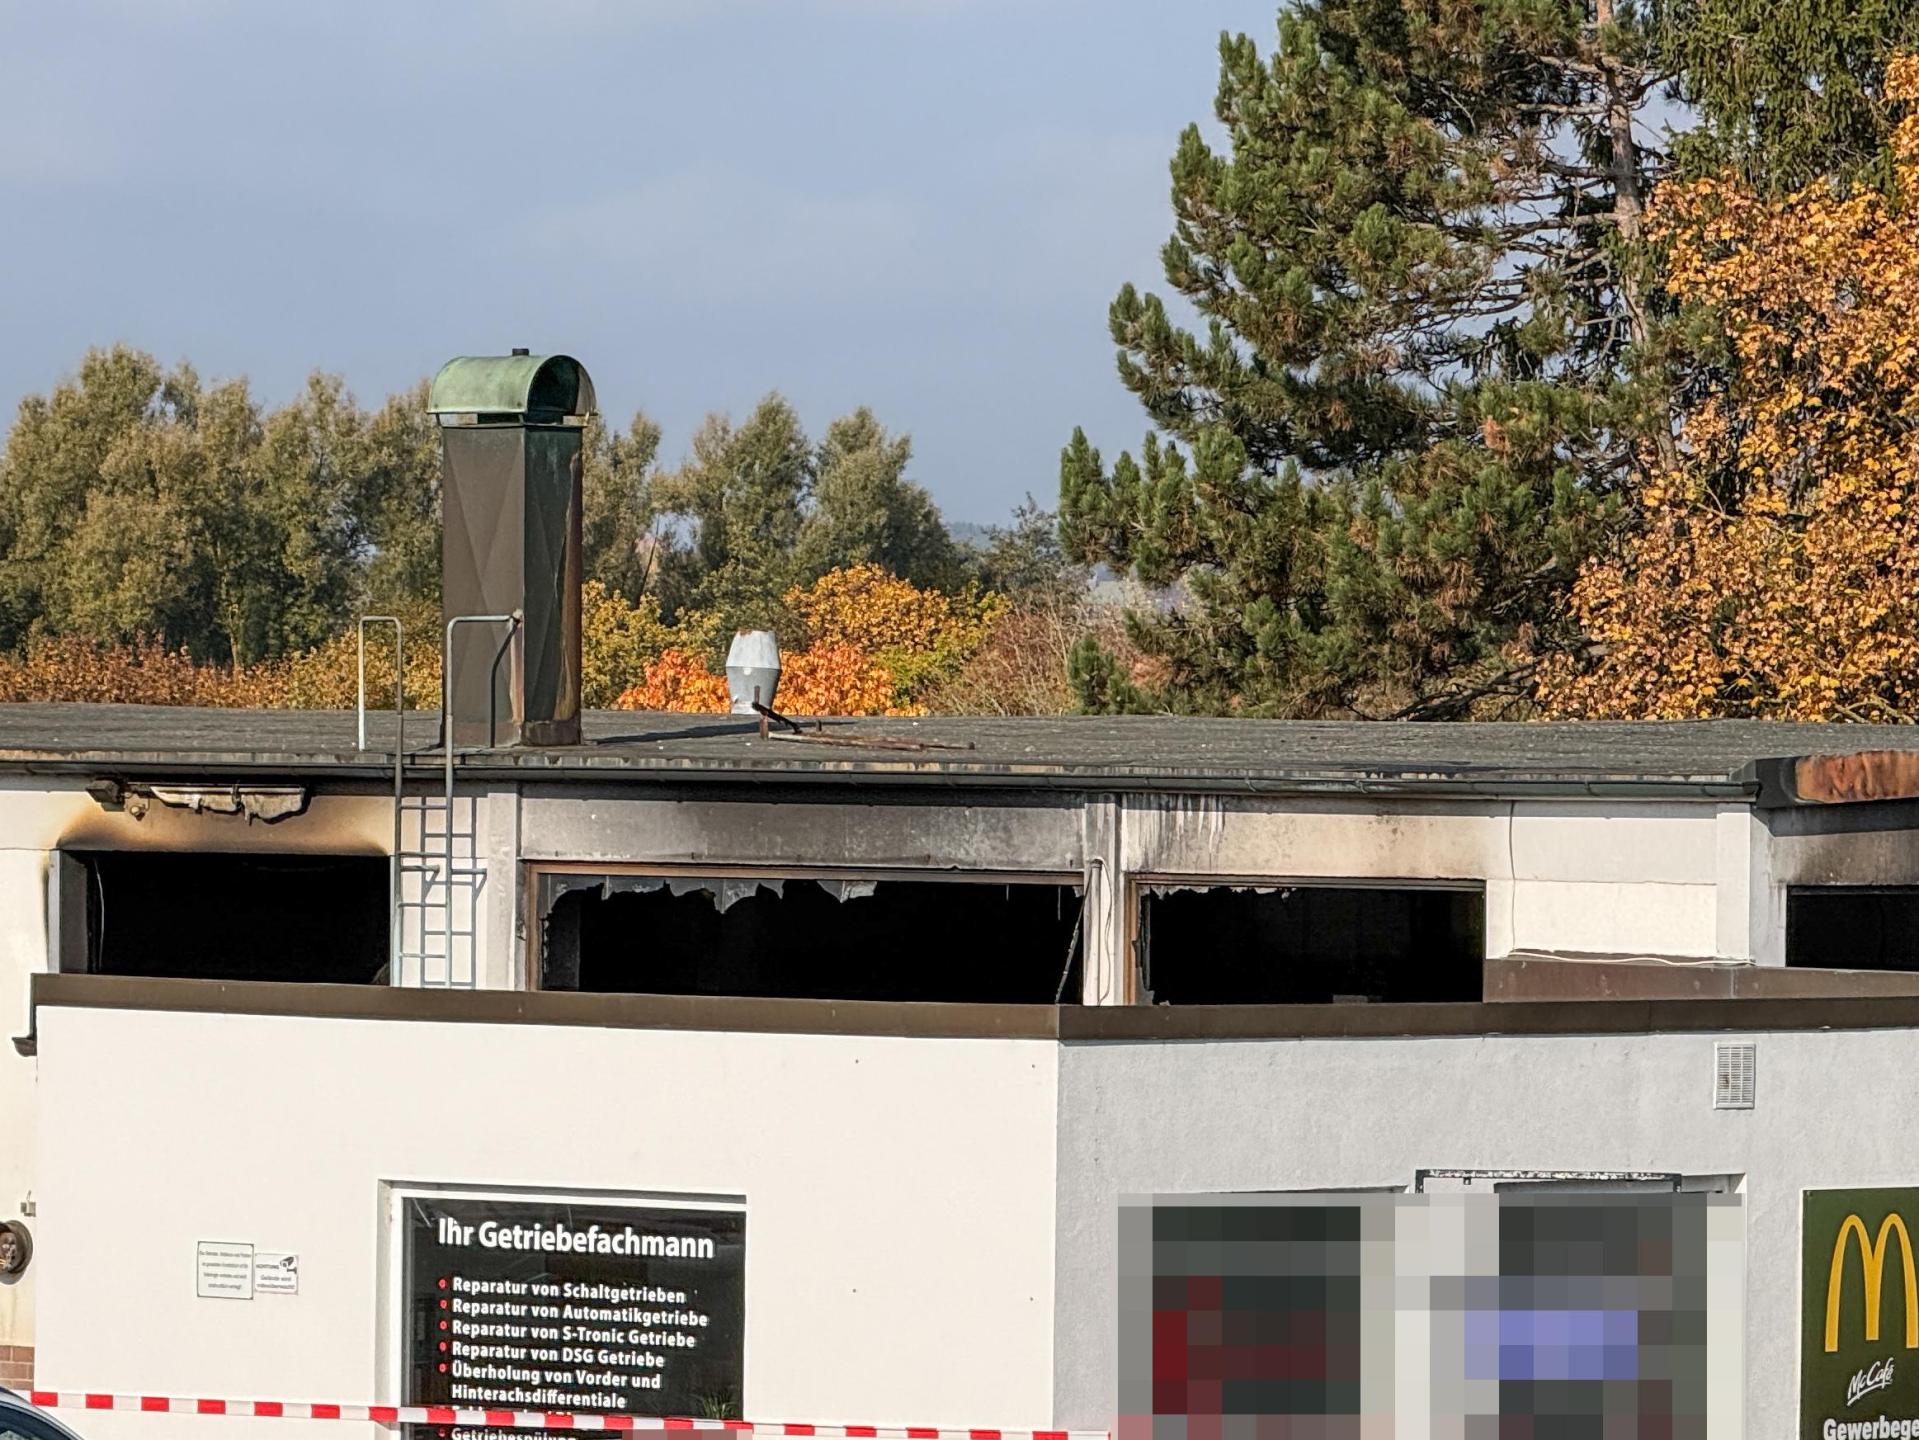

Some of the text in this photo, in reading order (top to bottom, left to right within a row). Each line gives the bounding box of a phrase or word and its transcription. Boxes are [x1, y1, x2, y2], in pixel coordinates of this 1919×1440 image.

[439, 1219, 714, 1259] Ihr Getriebefachmann
[453, 1277, 685, 1303] Reparatur von Schaltgetrieben
[453, 1298, 708, 1327] Reparatur von Automatikgetriebe
[453, 1320, 695, 1348] Reparatur von S-Tronic Getriebe
[452, 1341, 664, 1367] Reparatur von DSG Getriebe
[452, 1360, 661, 1389] Überholung von Vorder und
[452, 1384, 626, 1409] Hinterachsdifferentiale
